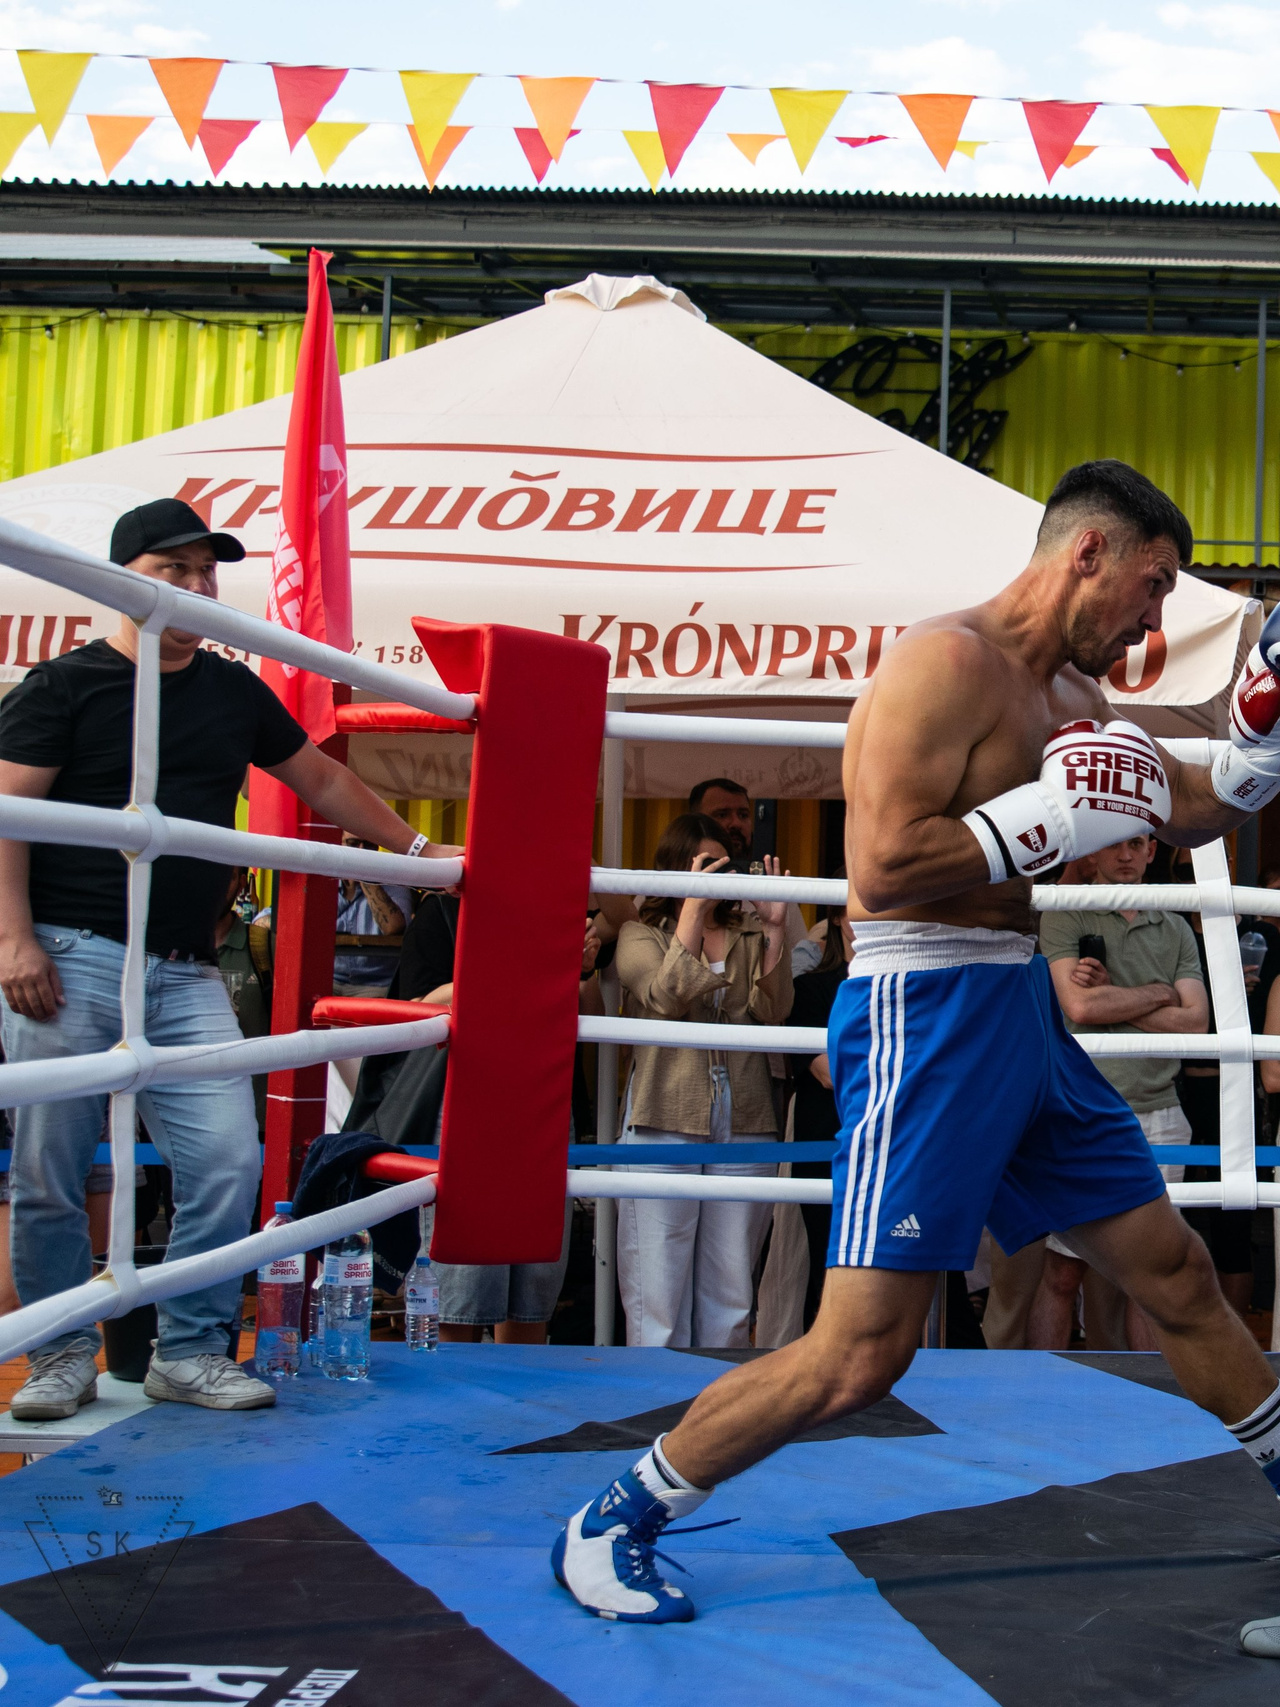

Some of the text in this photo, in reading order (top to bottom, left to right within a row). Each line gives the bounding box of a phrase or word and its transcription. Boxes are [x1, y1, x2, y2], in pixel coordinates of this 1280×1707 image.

[374, 645, 424, 664] 158
[1062, 751, 1164, 789] GREEN
[1066, 768, 1153, 806] HILL
[1232, 776, 1256, 796] GREEN
[1238, 784, 1260, 799] HILL
[1096, 800, 1106, 809] BE
[1107, 801, 1124, 812] YOUR
[1125, 804, 1140, 815] BEST
